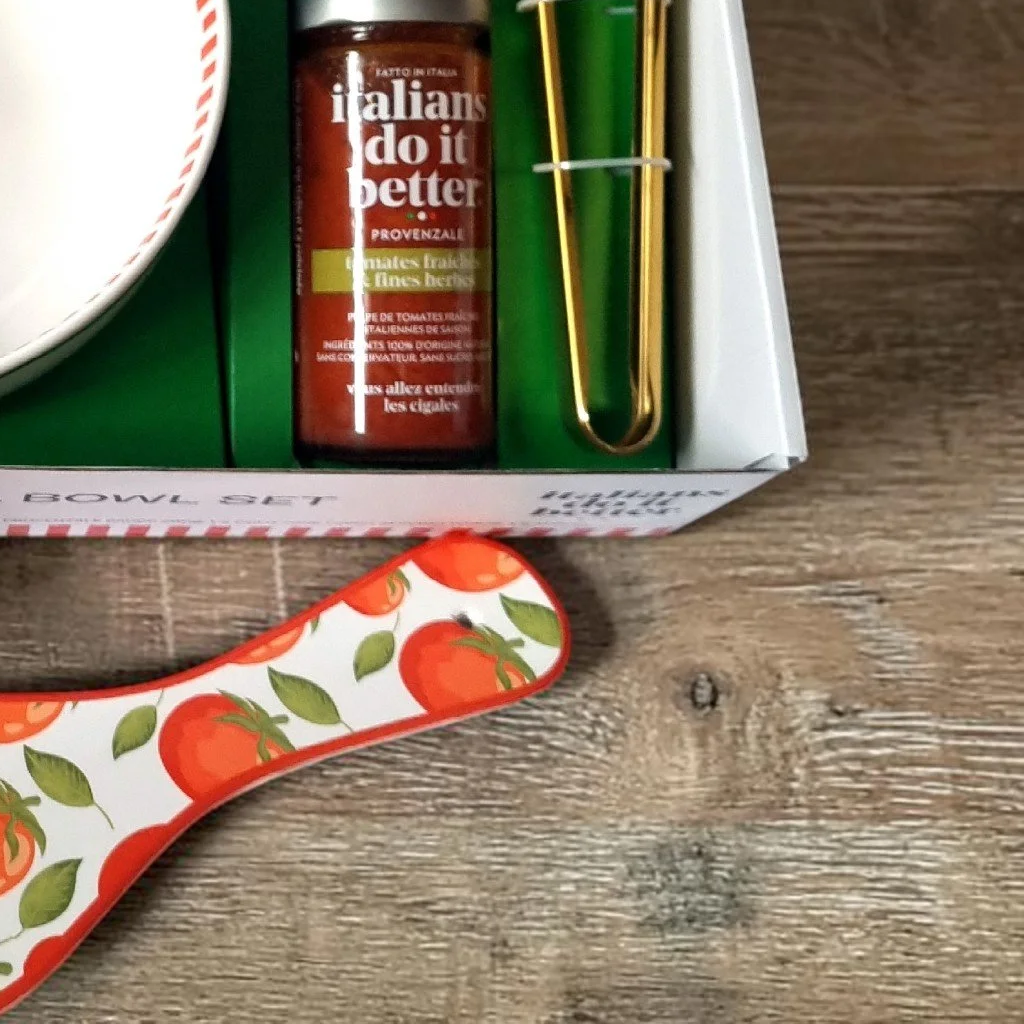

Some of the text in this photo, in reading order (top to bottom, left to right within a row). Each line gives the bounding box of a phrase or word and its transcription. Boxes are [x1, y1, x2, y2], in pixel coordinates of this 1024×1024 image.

[364, 123, 469, 165] do it
[346, 167, 482, 208] better
[371, 228, 465, 241] PROVENZALE
[344, 255, 420, 270] tmates
[346, 383, 383, 396] vus
[23, 492, 199, 505] BOWL
[219, 494, 338, 506] SET
